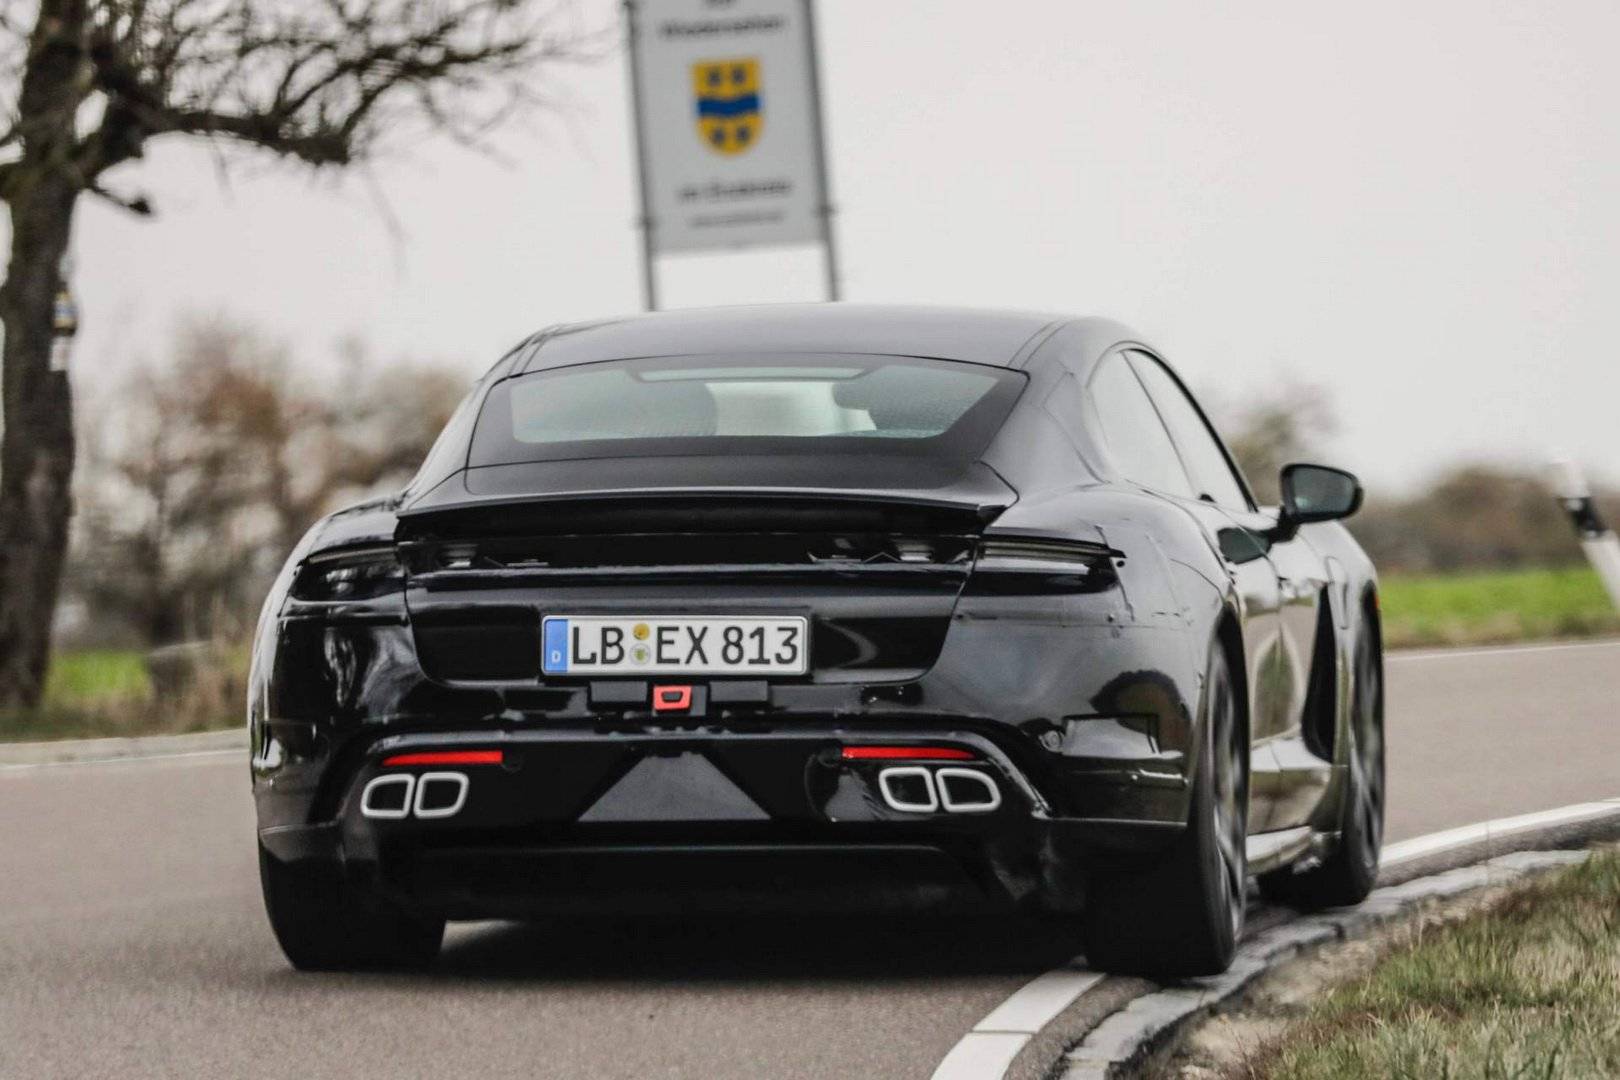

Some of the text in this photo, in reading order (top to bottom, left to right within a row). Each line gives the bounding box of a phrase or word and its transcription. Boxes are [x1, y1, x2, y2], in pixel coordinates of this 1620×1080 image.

[551, 651, 561, 663] D
[572, 626, 798, 665] LB EX 813
